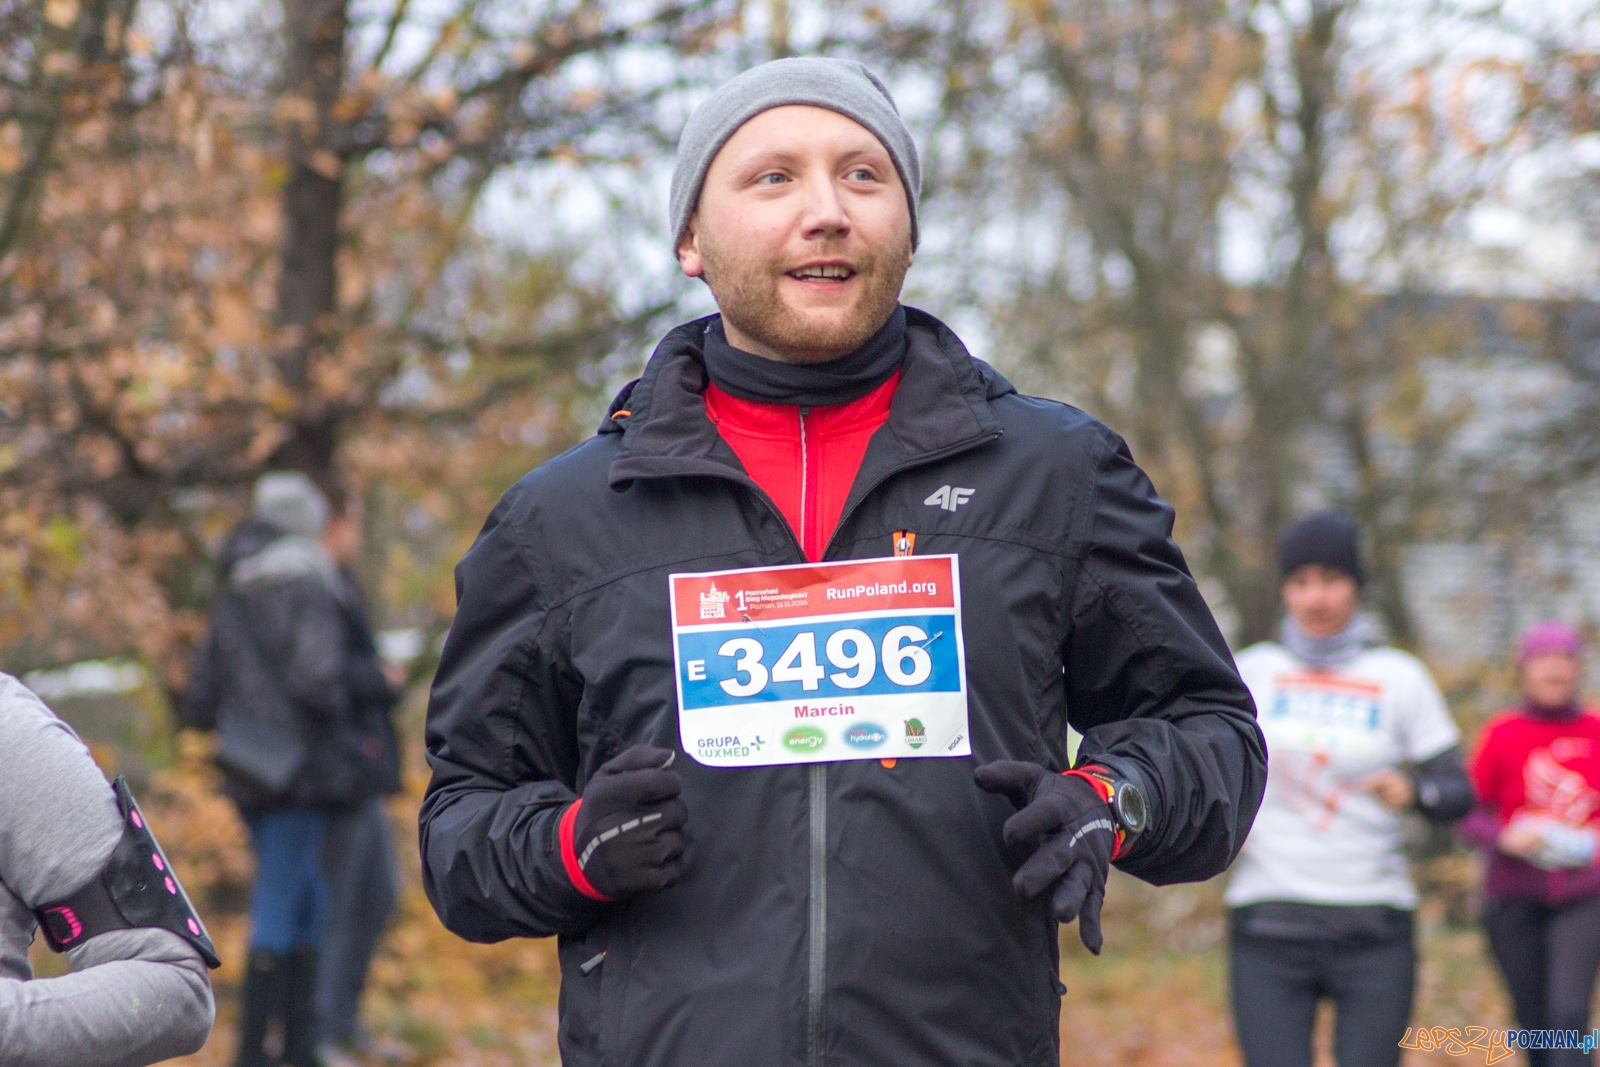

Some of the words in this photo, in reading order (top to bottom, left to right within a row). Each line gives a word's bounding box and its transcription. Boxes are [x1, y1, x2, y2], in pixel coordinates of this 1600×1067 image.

[924, 484, 976, 512] 4F
[826, 581, 936, 600] RunPoland.org
[687, 659, 706, 681] E
[717, 624, 932, 698] 3496
[794, 703, 855, 719] Marcin
[697, 736, 741, 748] GRUPA
[789, 735, 823, 748] energy
